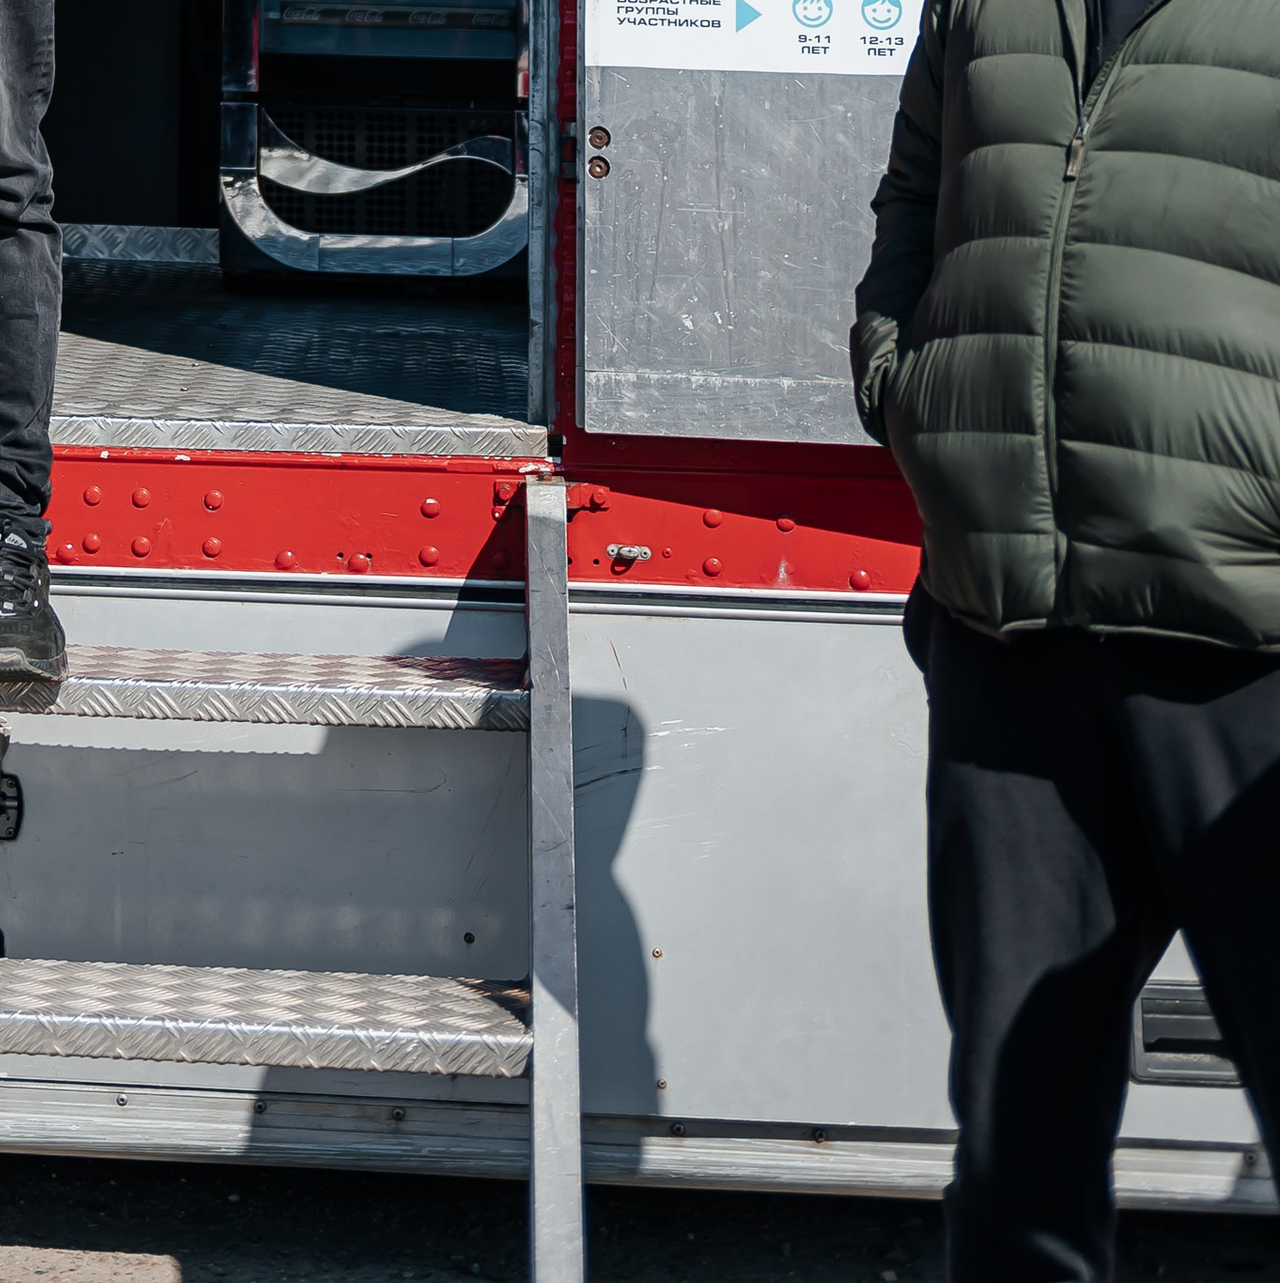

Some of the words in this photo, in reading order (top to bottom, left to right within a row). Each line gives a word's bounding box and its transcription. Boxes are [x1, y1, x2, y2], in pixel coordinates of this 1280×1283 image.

[617, 6, 679, 16] ГРУППЫ
[617, 17, 722, 28] УЧАСТНИКОВ
[798, 34, 832, 43] 9-11
[860, 36, 904, 46] 12-13
[801, 46, 830, 55] ЛЕТ
[867, 48, 896, 57] ЛЕТ
